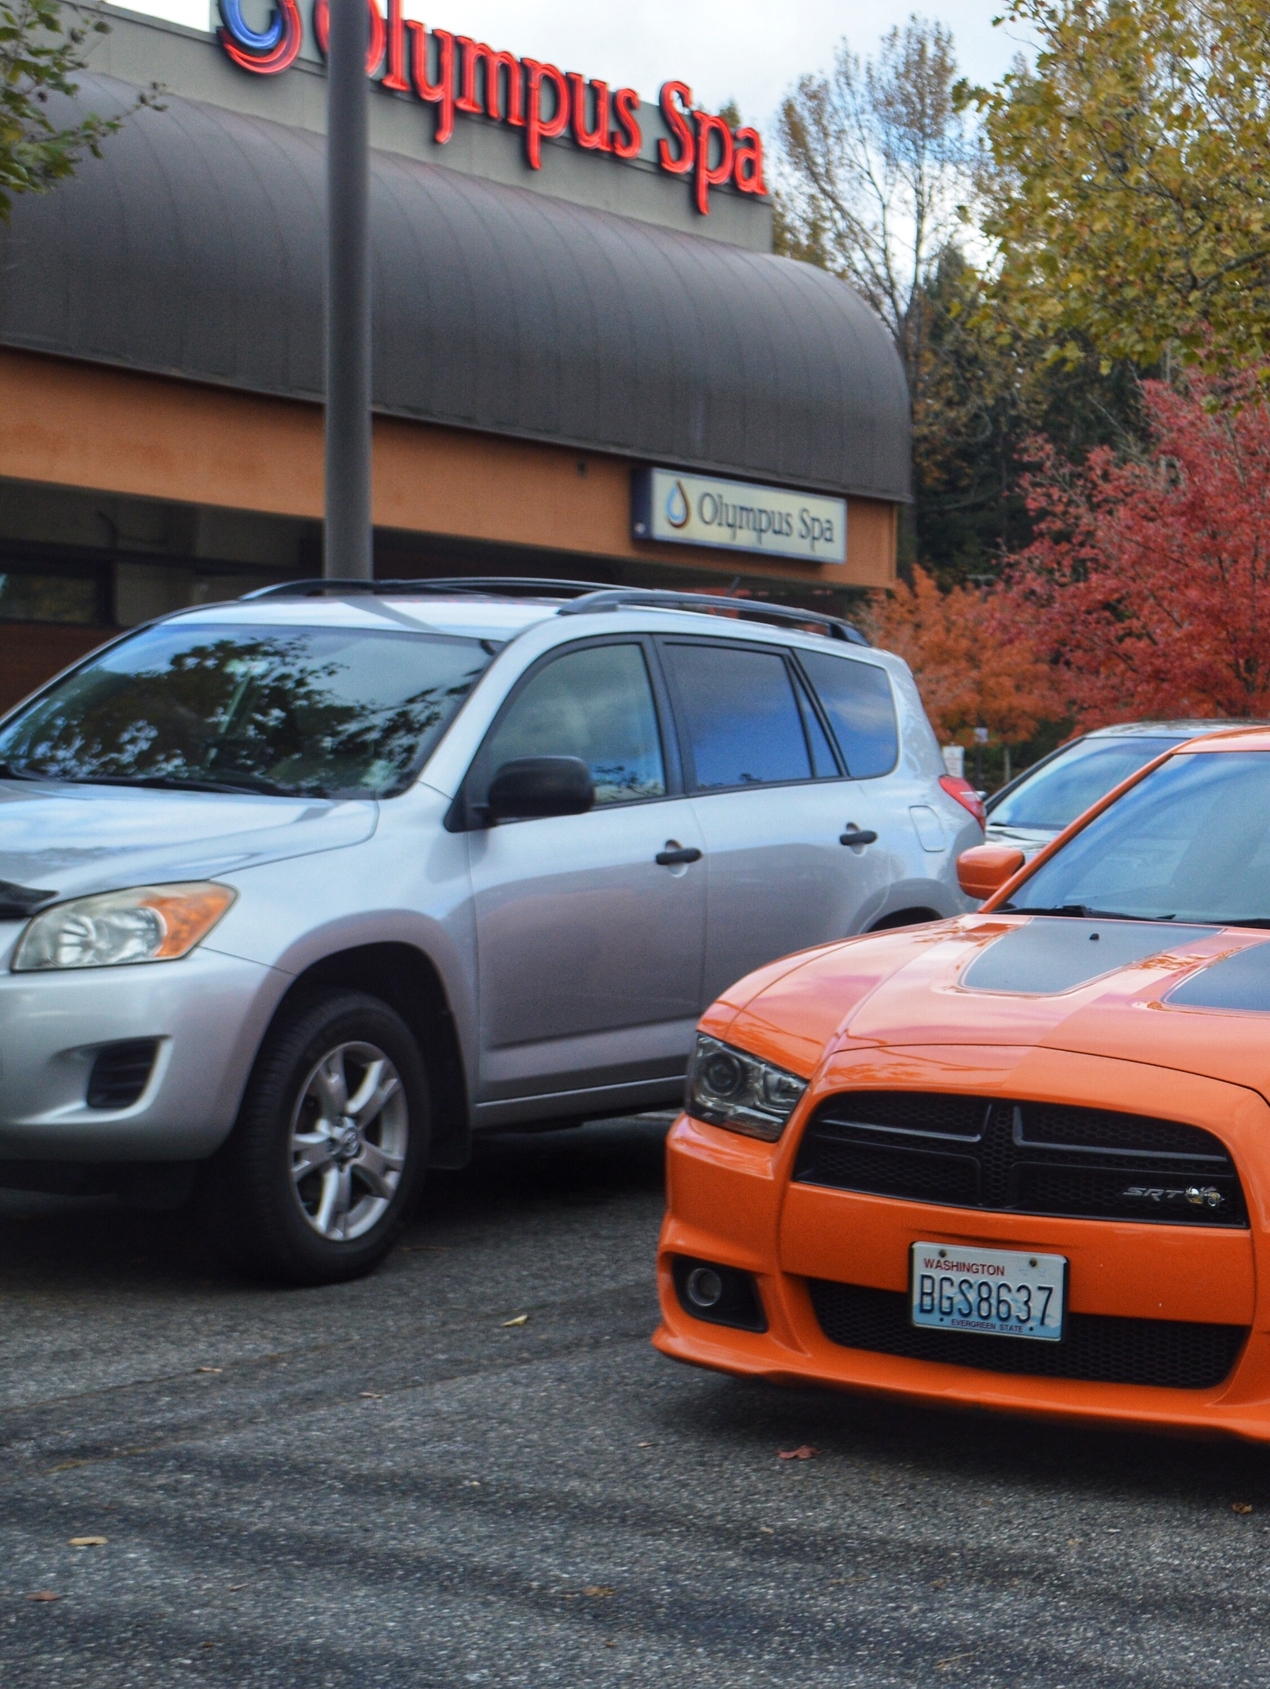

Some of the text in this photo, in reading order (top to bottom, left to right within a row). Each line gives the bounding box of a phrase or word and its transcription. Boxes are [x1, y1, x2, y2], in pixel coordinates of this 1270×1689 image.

[658, 80, 768, 214] Spa
[700, 492, 835, 551] Olympus Spa
[1123, 1186, 1184, 1201] SRT
[924, 1257, 1006, 1277] WASHINGTON
[919, 1273, 1054, 1327] BGS8637
[951, 1318, 1024, 1333] EVERGREEN STATE
